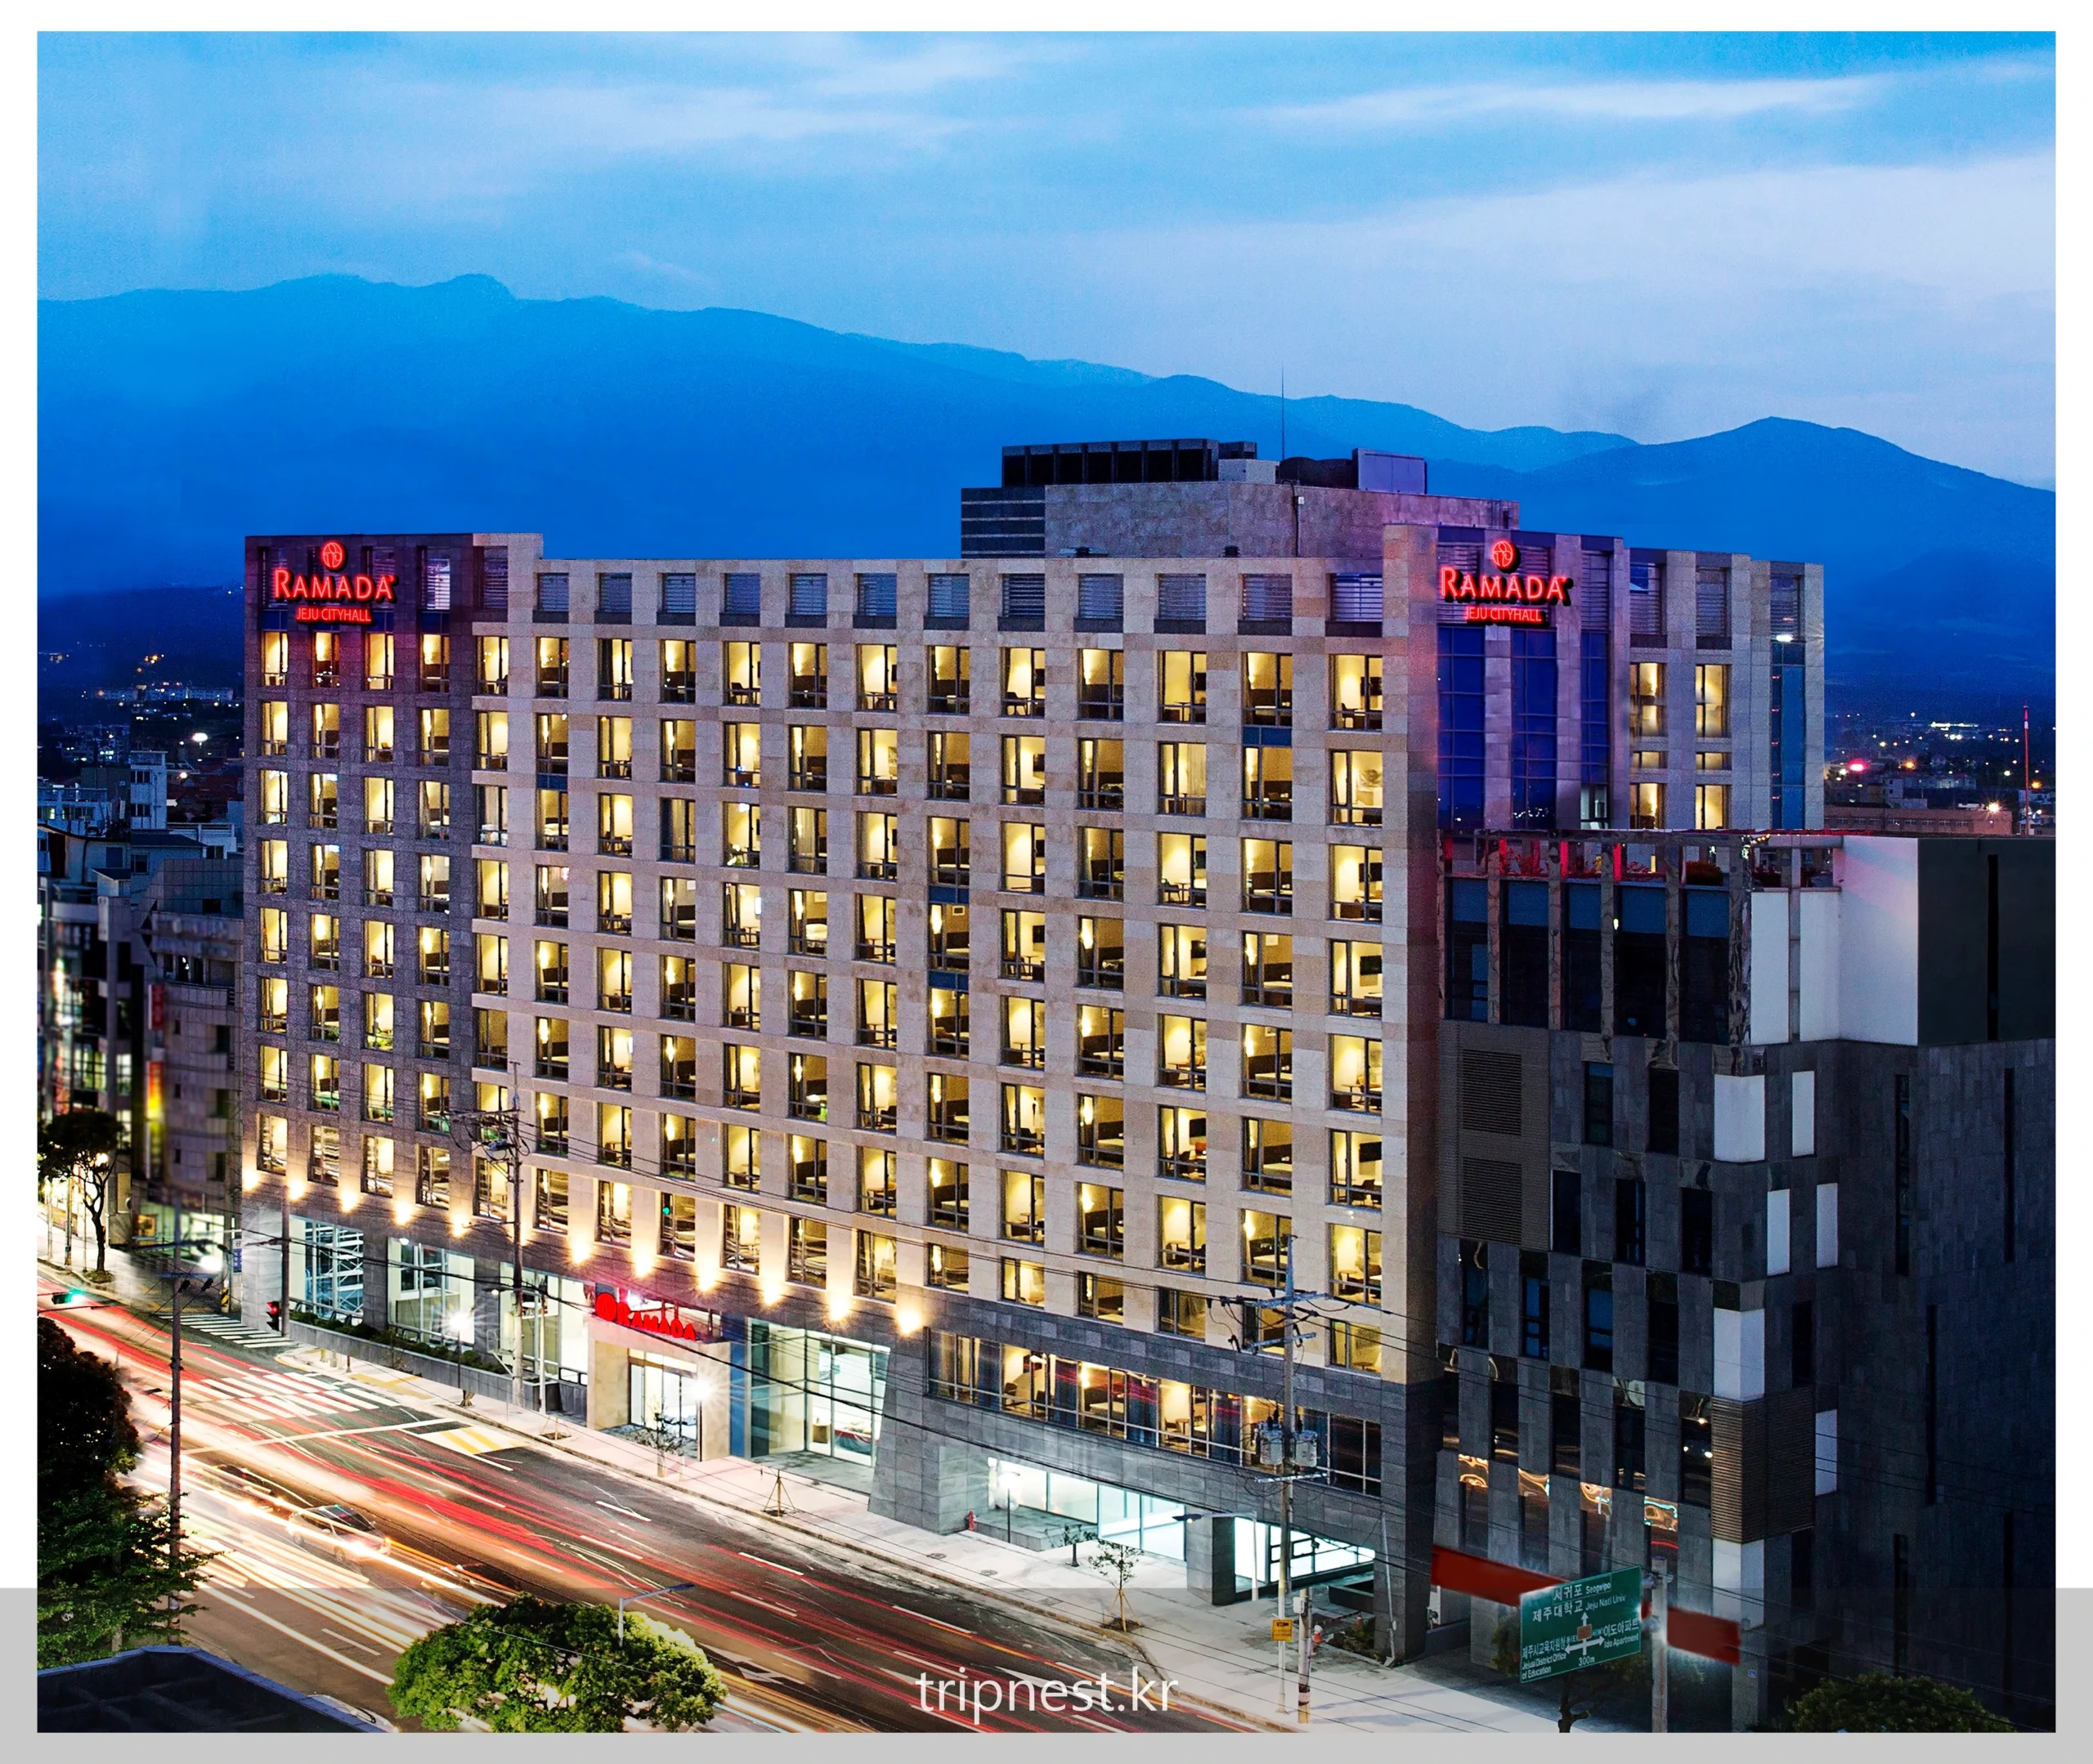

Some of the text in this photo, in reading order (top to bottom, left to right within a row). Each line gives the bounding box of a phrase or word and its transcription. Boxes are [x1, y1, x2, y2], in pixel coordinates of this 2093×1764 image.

[274, 569, 394, 600] RAMADA
[1441, 567, 1566, 600] RAMADA
[296, 607, 371, 622] JEJU CITYHALL
[1466, 607, 1542, 621] JEJU CITYHALL
[617, 1301, 697, 1341] RAMADA
[1553, 1583, 1583, 1601] 서귀포
[1585, 1583, 1611, 1595] Seogwipo
[1532, 1600, 1584, 1623] 제주대학교
[1585, 1601, 1598, 1611] Jeju
[1603, 1618, 1639, 1637] 이도아파트
[1578, 1656, 1595, 1667] 300m
[1527, 1666, 1552, 1679] Education
